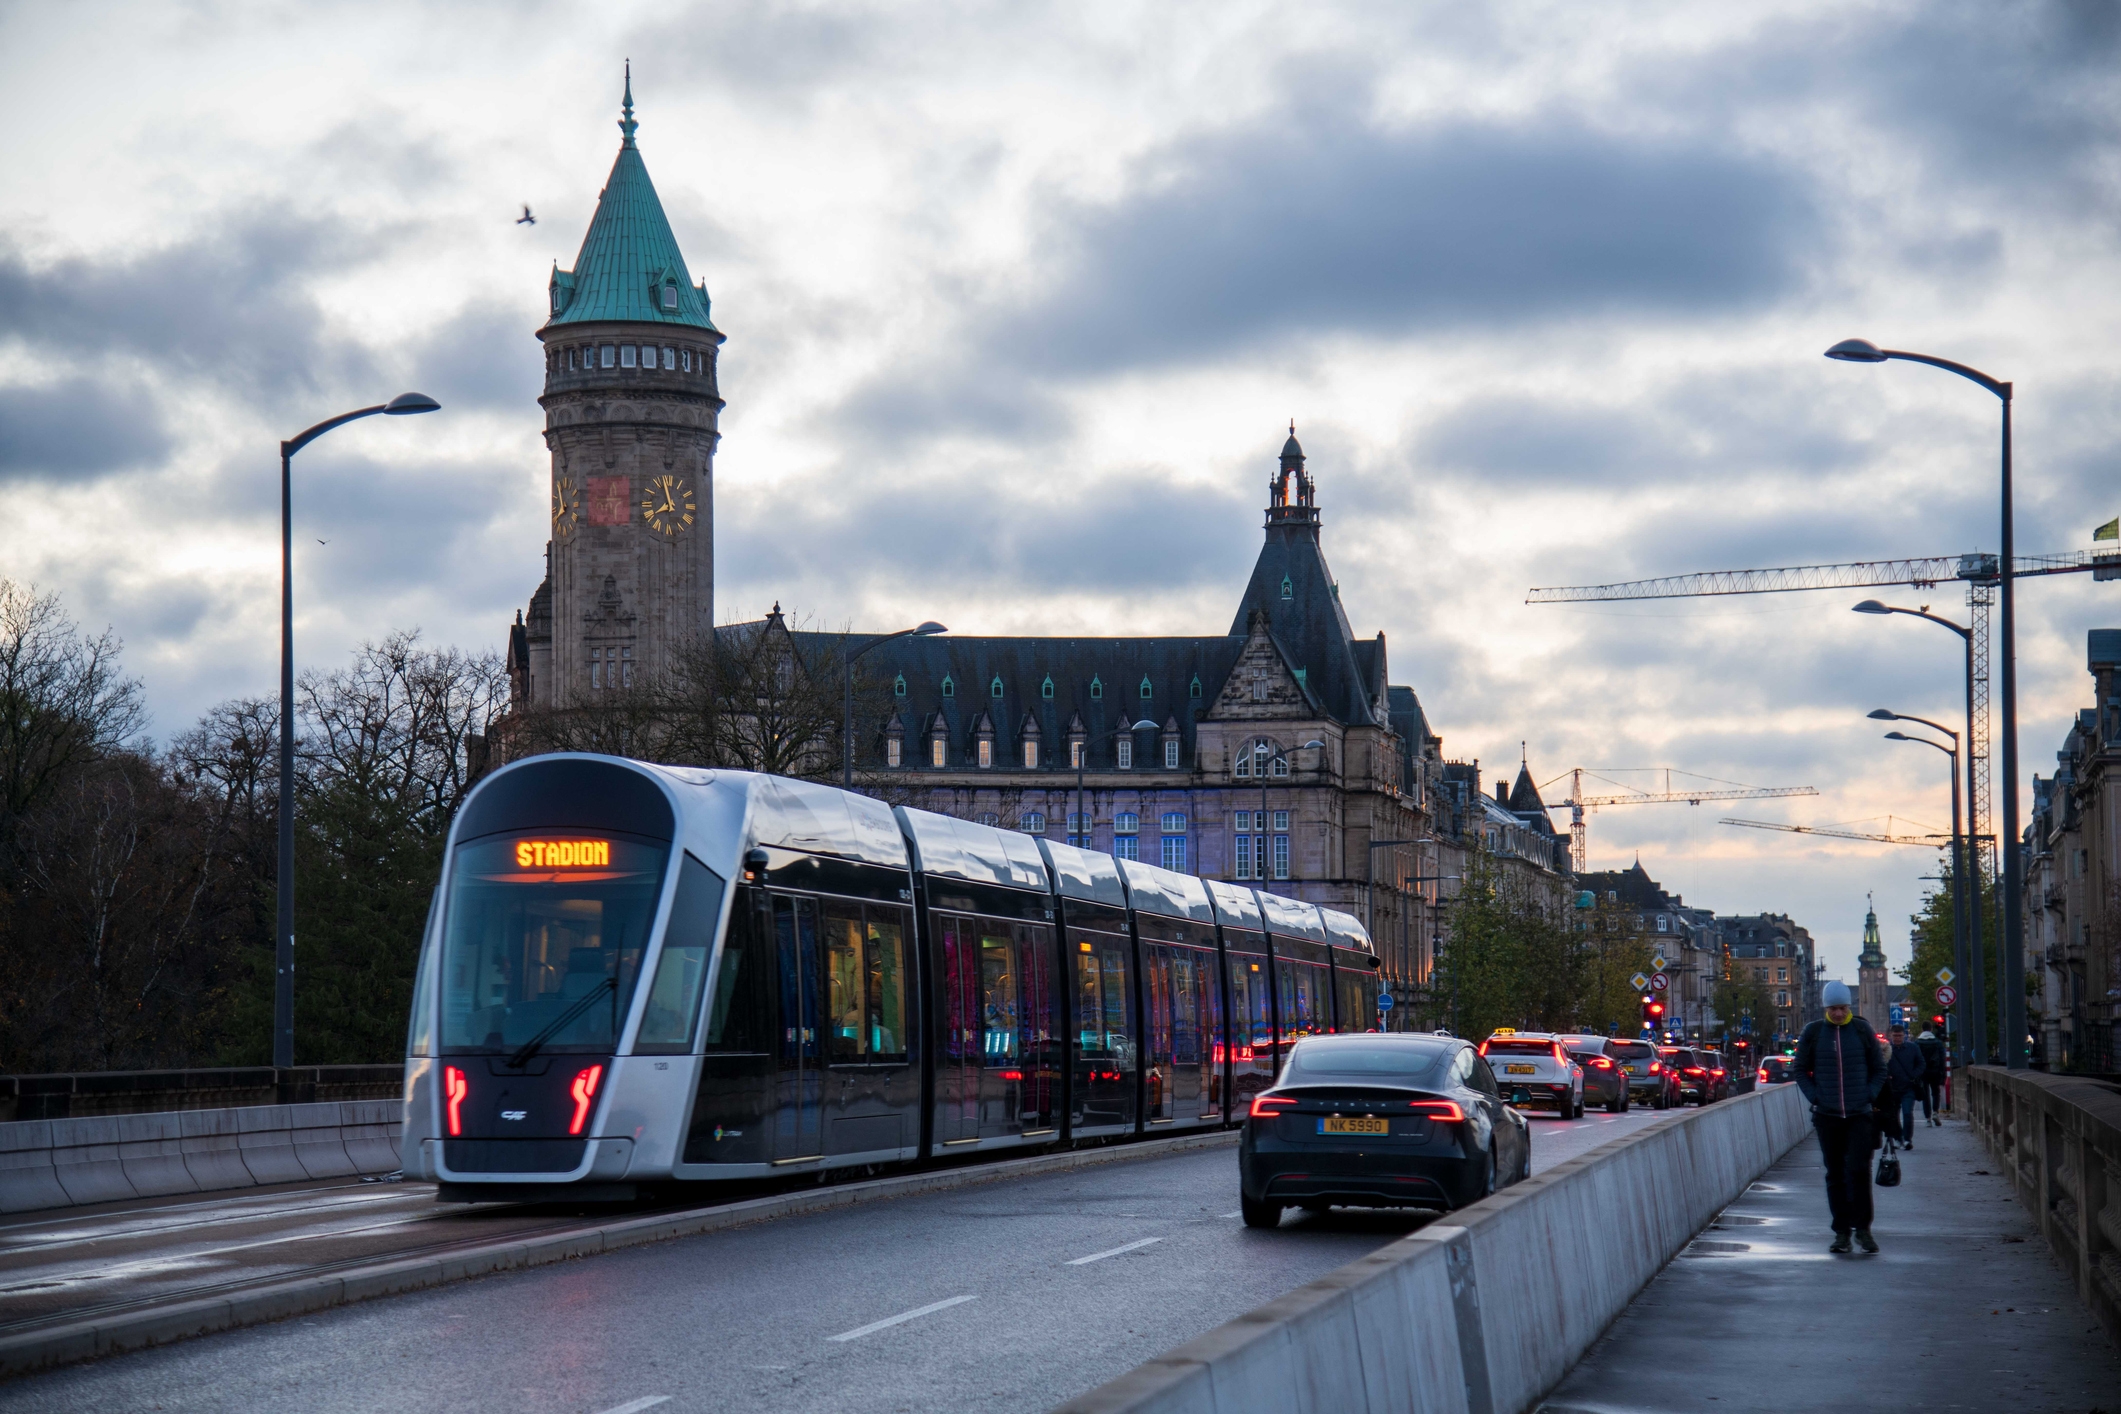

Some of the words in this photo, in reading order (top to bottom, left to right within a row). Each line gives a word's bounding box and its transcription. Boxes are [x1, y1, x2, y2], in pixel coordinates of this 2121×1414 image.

[517, 841, 609, 867] STADION
[1330, 1119, 1346, 1132] NK
[1349, 1119, 1382, 1132] 5990
